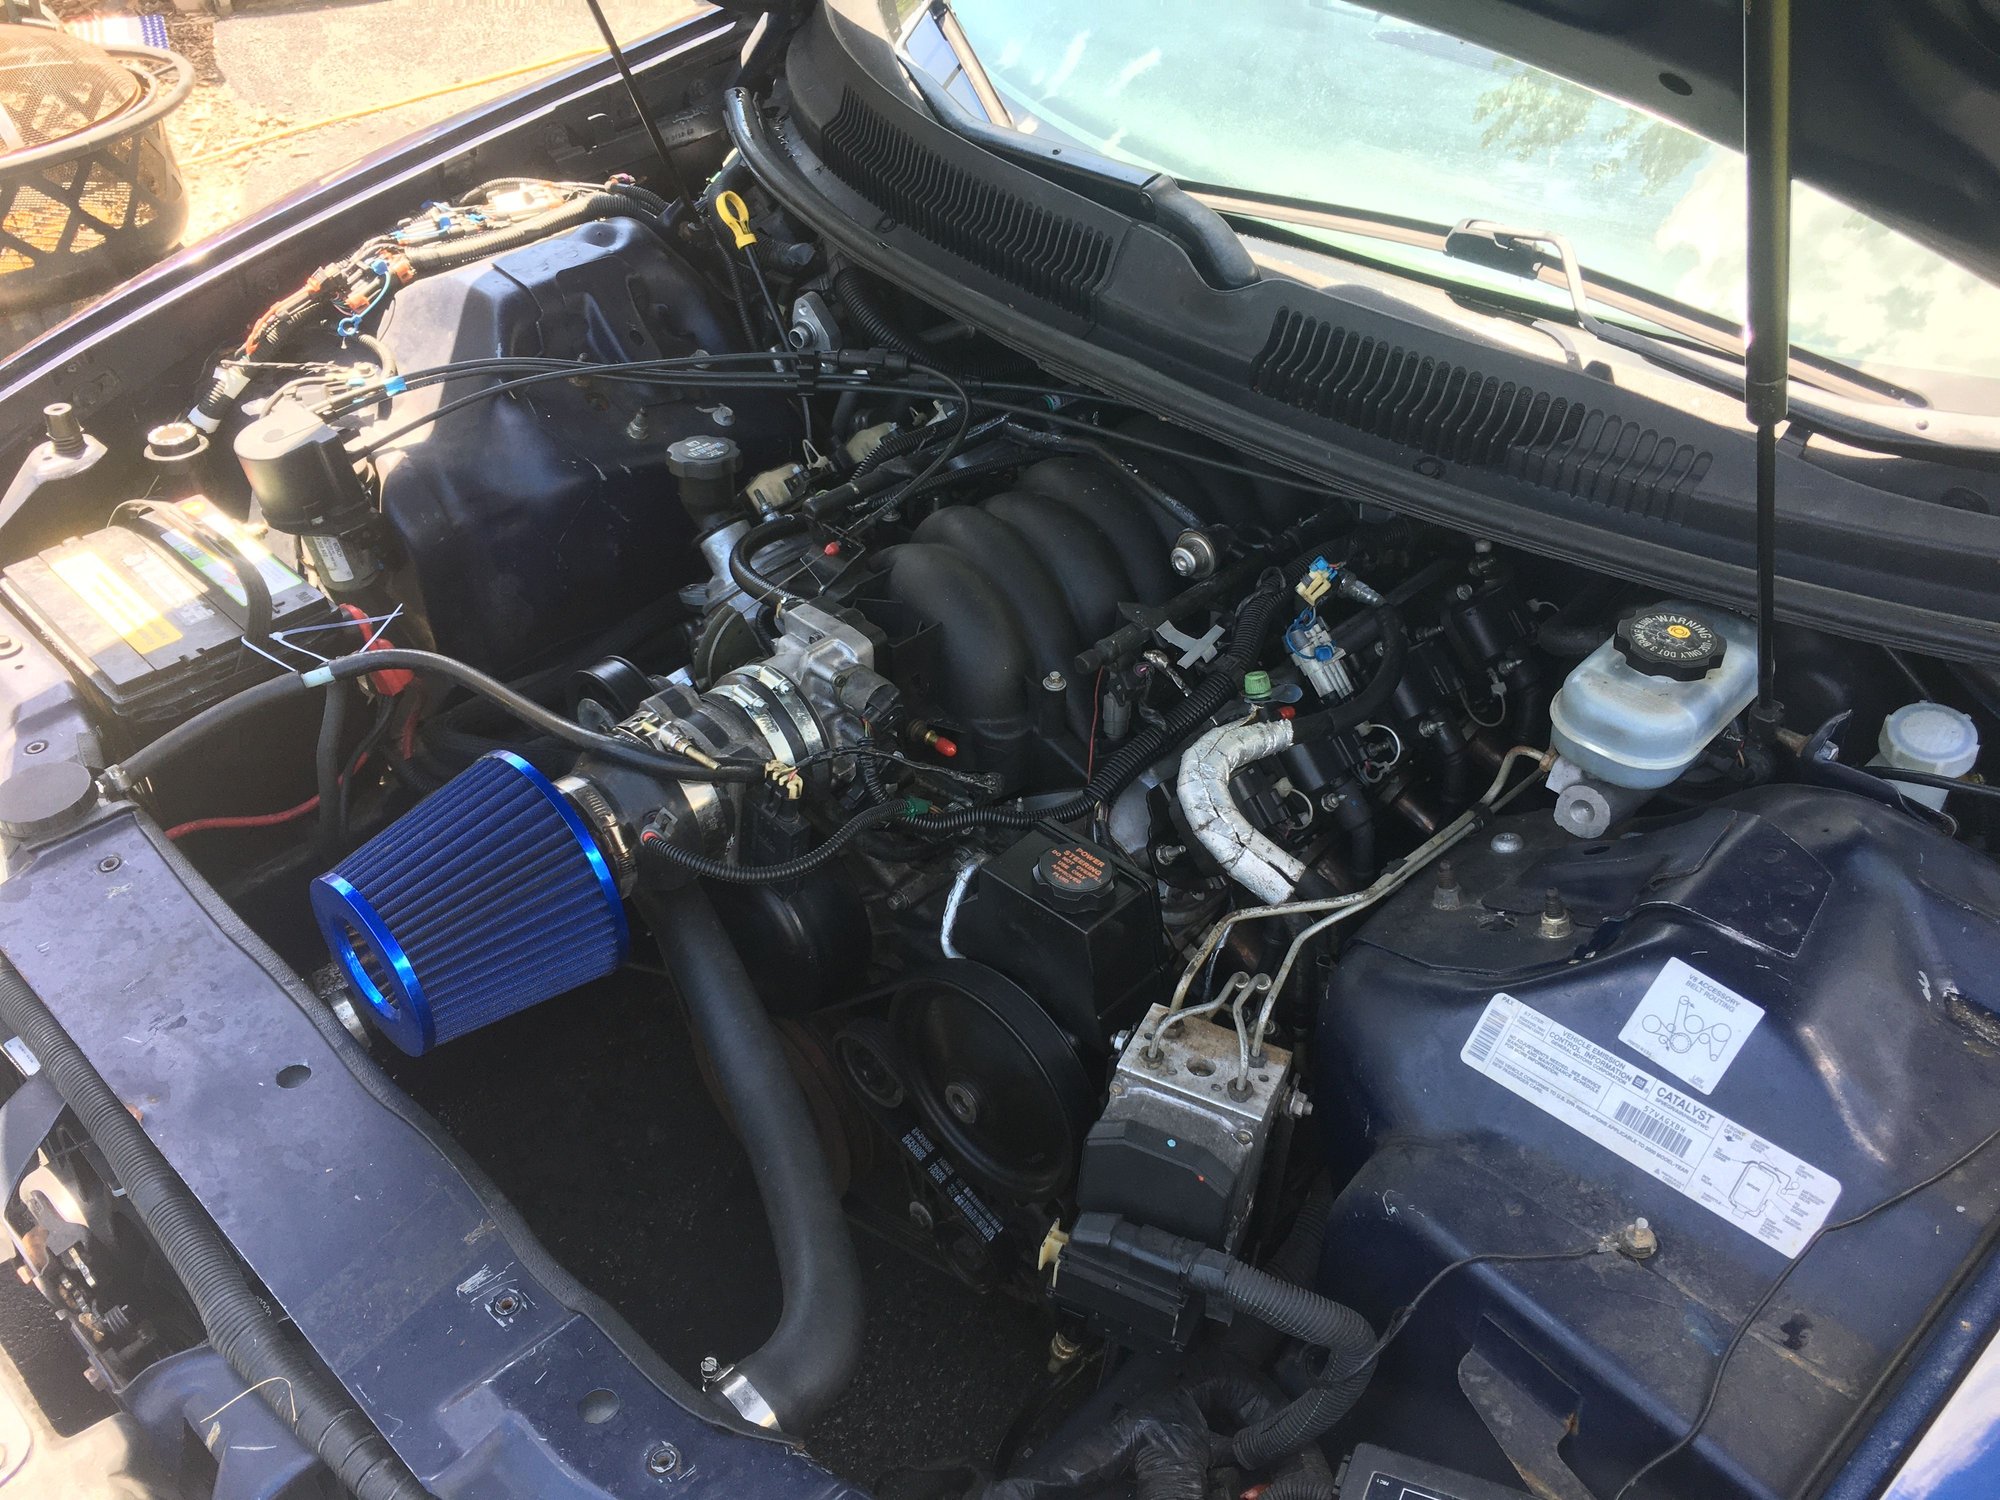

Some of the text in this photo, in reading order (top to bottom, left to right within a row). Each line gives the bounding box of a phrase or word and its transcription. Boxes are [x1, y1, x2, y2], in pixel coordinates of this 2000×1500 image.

[1656, 614, 1712, 639] WARNING
[1658, 649, 1676, 658] DOT
[1680, 650, 1702, 658] ONLY
[1057, 860, 1086, 880] USE ONLY
[1062, 856, 1075, 866] NOT
[1064, 850, 1102, 876] STEERING
[1076, 848, 1105, 868] POWER
[1051, 864, 1082, 884] APPROVED
[1052, 872, 1069, 884] FLUID
[1501, 996, 1514, 1006] PAX
[1684, 979, 1735, 1013] BELT ROUTING
[1688, 973, 1740, 1007] V8 ACCESSORY
[1503, 1041, 1514, 1050] FOR
[1513, 1047, 1528, 1058] MORE
[1508, 1033, 1518, 1042] NO
[1517, 1038, 1549, 1060] ADJUSTMENTS
[1570, 1069, 1581, 1078] SEE
[1580, 1075, 1601, 1090] SERVICE
[1548, 1030, 1632, 1082] CONTROL INFORMATION
[1561, 1029, 1592, 1051] VEHICLE
[1591, 1046, 1626, 1070] EMISSION
[1491, 1061, 1502, 1069] NEW
[1501, 1066, 1529, 1085] PASSENGER
[1506, 1037, 1599, 1094] MANUAL AND MAINTENANCE SCHEDULE
[1550, 1038, 1626, 1086] GENERAL MOTORS CORPORATION
[1493, 1056, 1504, 1065] THIS
[1503, 1062, 1523, 1076] VEHICLE
[1522, 1074, 1549, 1092] CONFORMS
[1575, 1104, 1608, 1126] REGULATIONS
[1607, 1123, 1638, 1144] APPLICABLE
[1655, 1085, 1715, 1126] CATALYST
[1723, 1127, 1733, 1136] OF
[1726, 1123, 1745, 1137] FRONT
